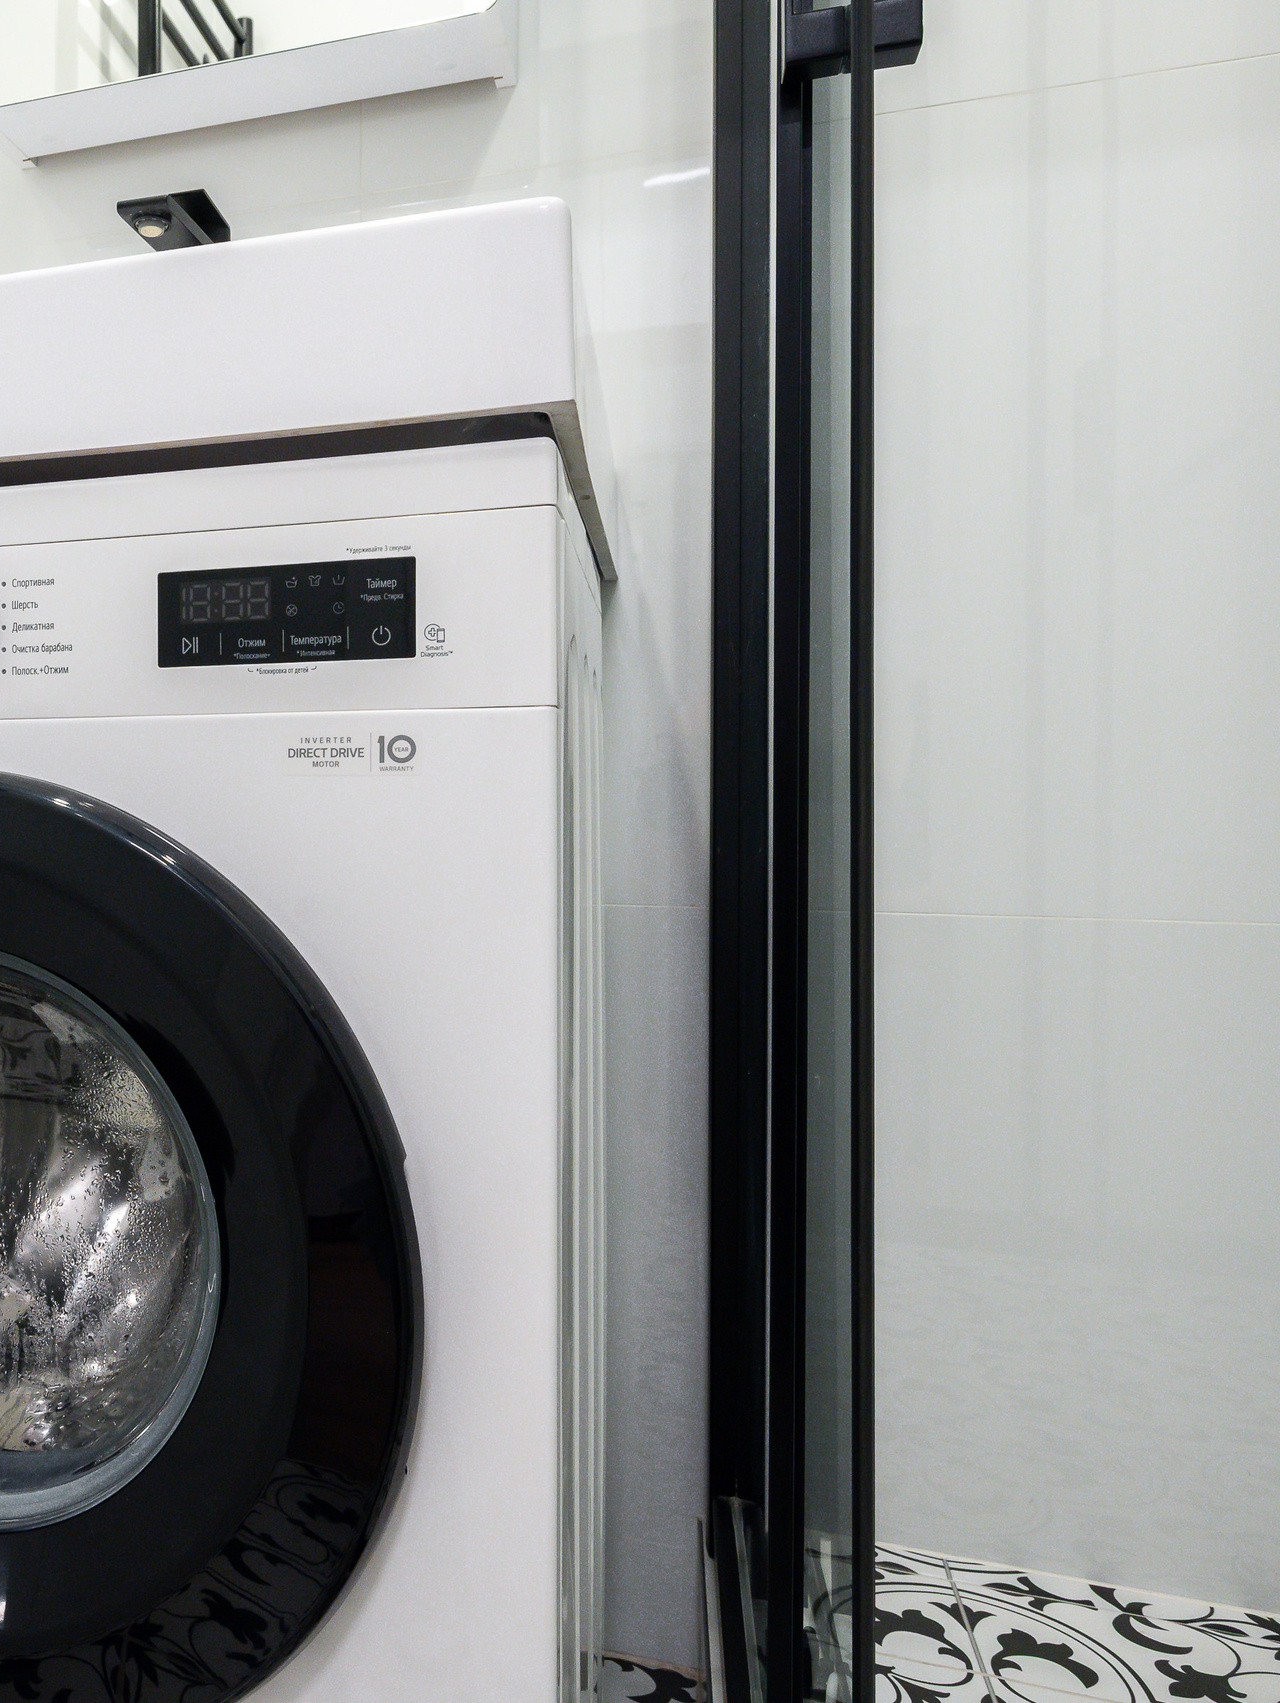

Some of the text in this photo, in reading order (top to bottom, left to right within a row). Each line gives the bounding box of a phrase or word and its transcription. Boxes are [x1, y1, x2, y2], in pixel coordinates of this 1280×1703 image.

[11, 578, 55, 589] Спортивная
[366, 578, 397, 590] Таймер
[383, 593, 404, 602] Стирка
[11, 600, 39, 611] Шерсть
[11, 622, 55, 633] Деликатная
[238, 637, 266, 648] Отжим
[290, 634, 342, 647] Температура
[11, 642, 73, 654] Очистка барабана
[11, 665, 69, 676] Полоск.+Отжим
[294, 666, 309, 675] детей
[300, 736, 352, 744] INVERTER
[287, 747, 365, 758] DIRECT DRIVE
[377, 734, 417, 764] 10
[312, 760, 340, 768] MOTOR
